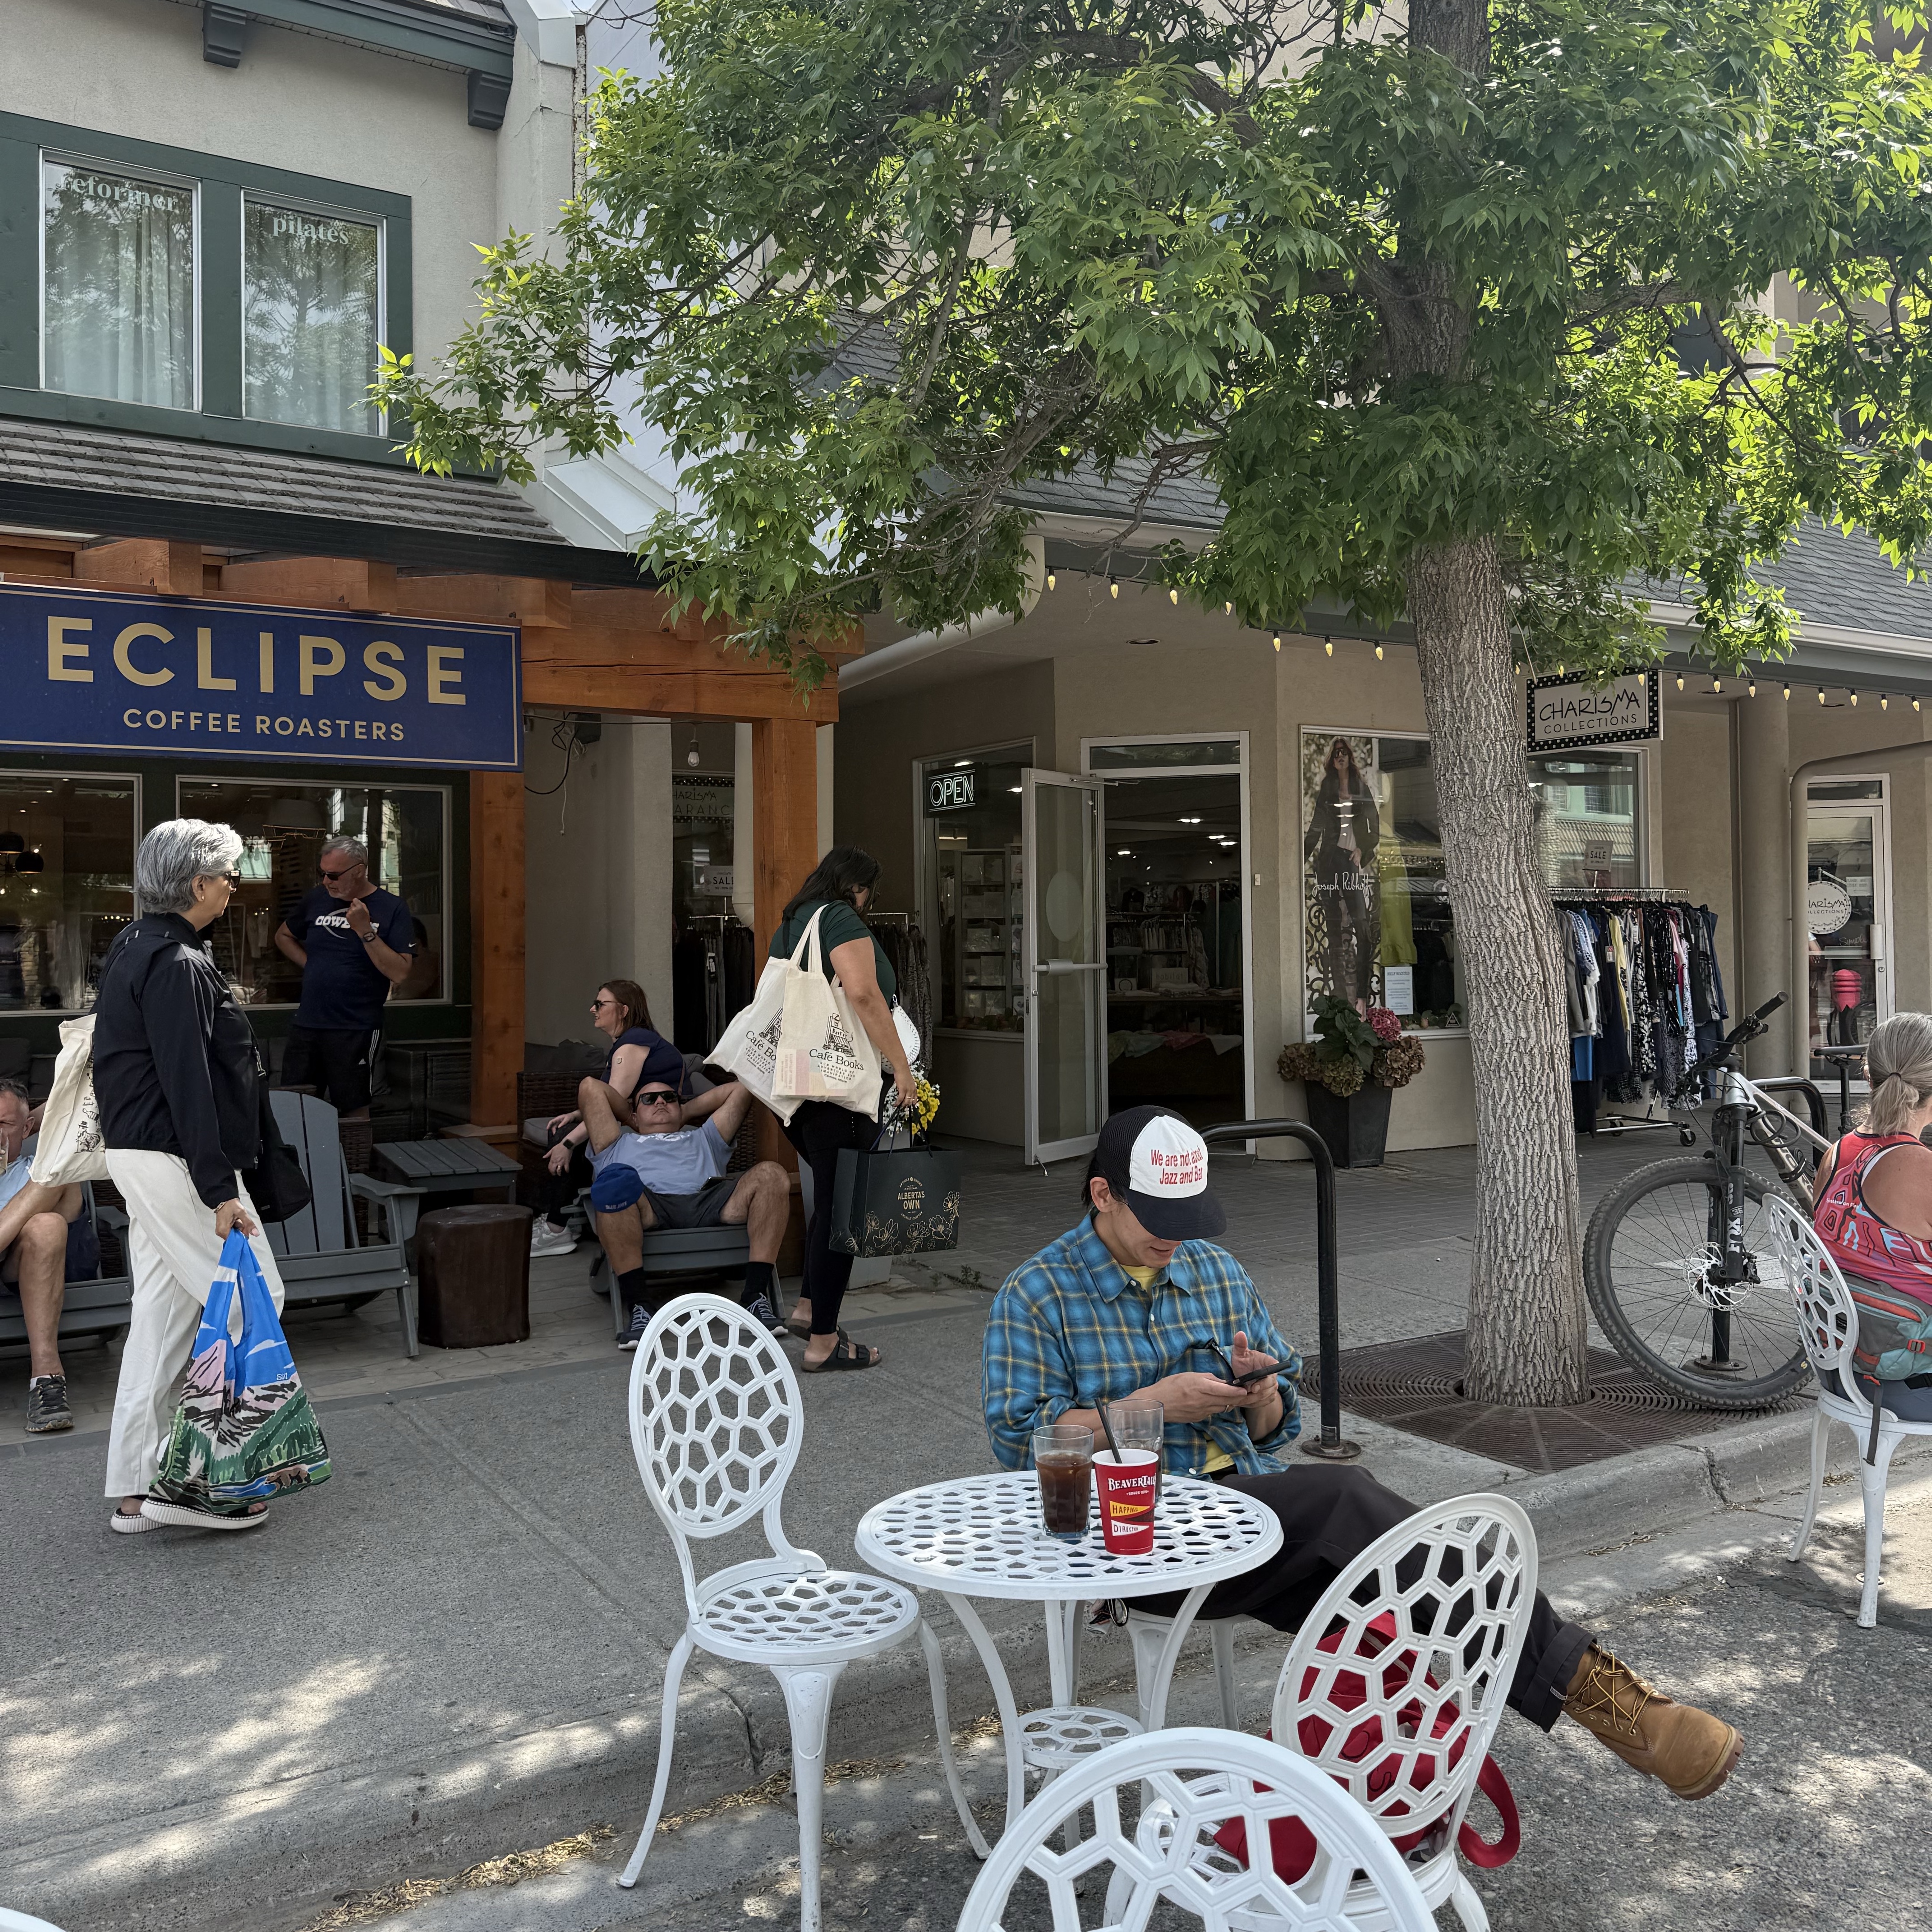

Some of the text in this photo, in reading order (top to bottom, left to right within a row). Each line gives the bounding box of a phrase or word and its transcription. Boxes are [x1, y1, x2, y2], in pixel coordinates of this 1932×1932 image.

[61, 175, 178, 212] reformer
[272, 216, 350, 244] pilates
[48, 616, 467, 705] ECLIPSE
[123, 708, 404, 741] COFFEE ROASTERS
[1544, 714, 1637, 734] COLLECTIONS
[930, 774, 974, 806] OPEN
[675, 804, 731, 815] ARANC
[1590, 851, 1607, 859] SALE
[1312, 871, 1339, 897] Joseph
[809, 1049, 864, 1071] Café Books
[1150, 1149, 1164, 1166] We
[1165, 1155, 1178, 1167] are
[1159, 1168, 1178, 1185] Jazz
[1179, 1166, 1193, 1184] and
[903, 1199, 920, 1210] OWN
[1727, 1217, 1743, 1253] FOX
